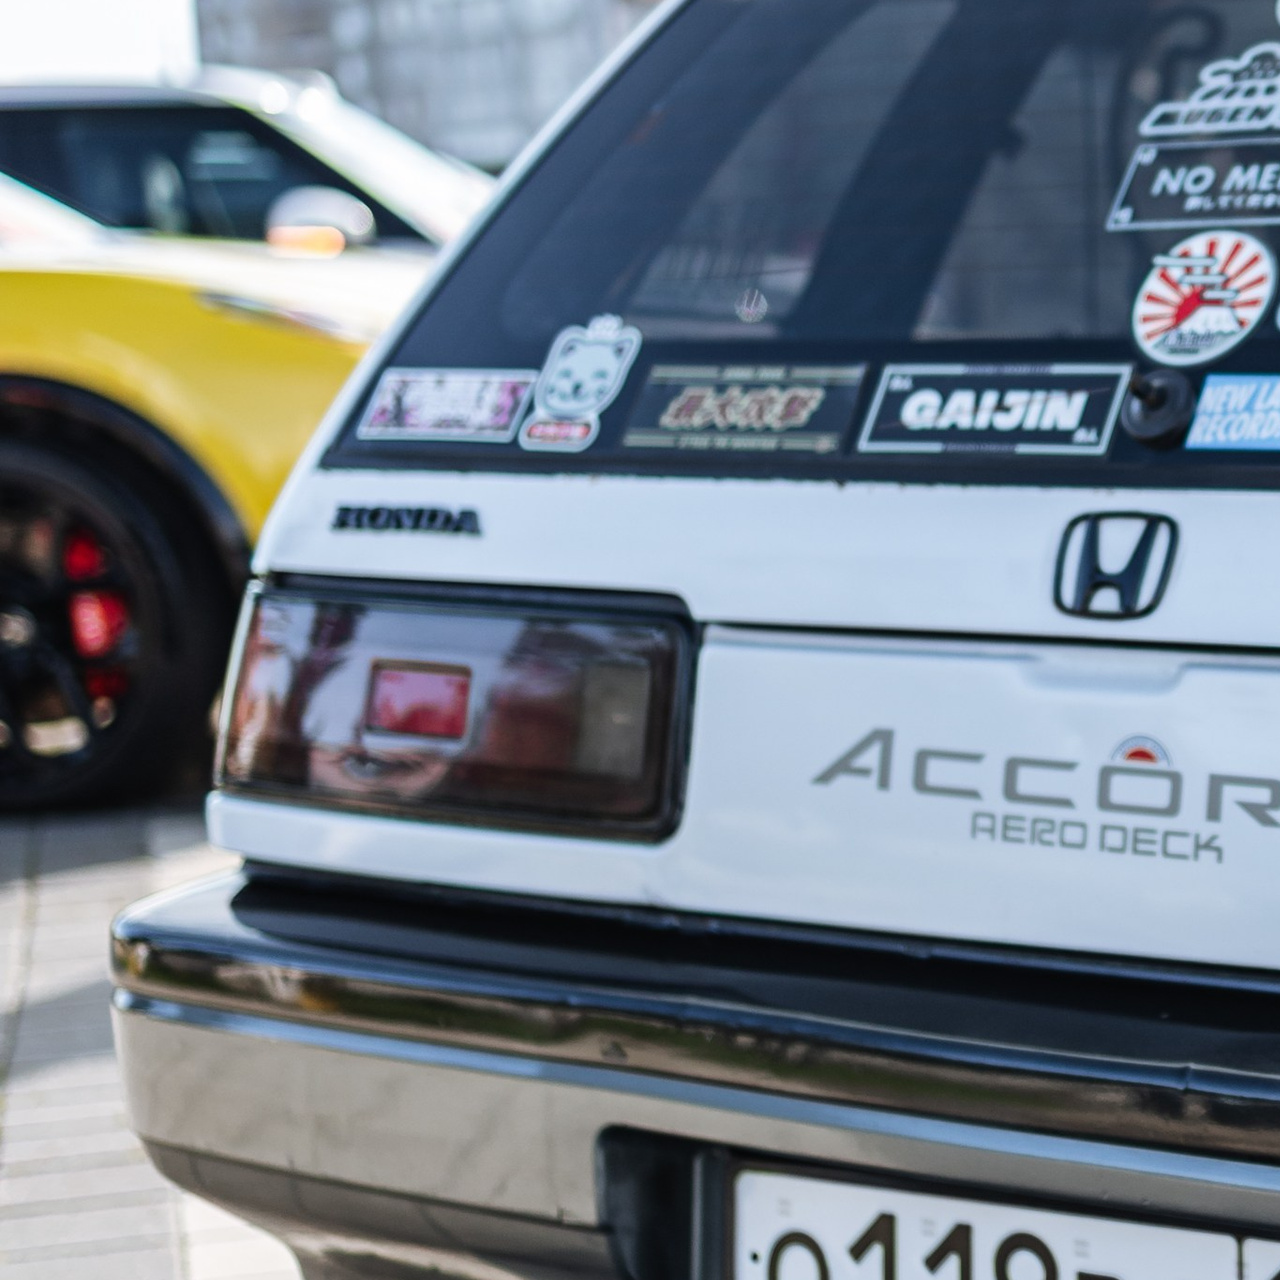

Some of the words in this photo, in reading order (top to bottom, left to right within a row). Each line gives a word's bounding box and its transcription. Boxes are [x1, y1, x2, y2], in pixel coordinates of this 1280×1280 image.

[1151, 104, 1271, 127] MUGEN
[1150, 164, 1217, 197] NO
[899, 387, 1089, 432] GAIJIN
[1198, 384, 1257, 414] NEW
[332, 506, 480, 535] HONDA
[970, 810, 1088, 851] AERO
[1098, 822, 1225, 865] DECK
